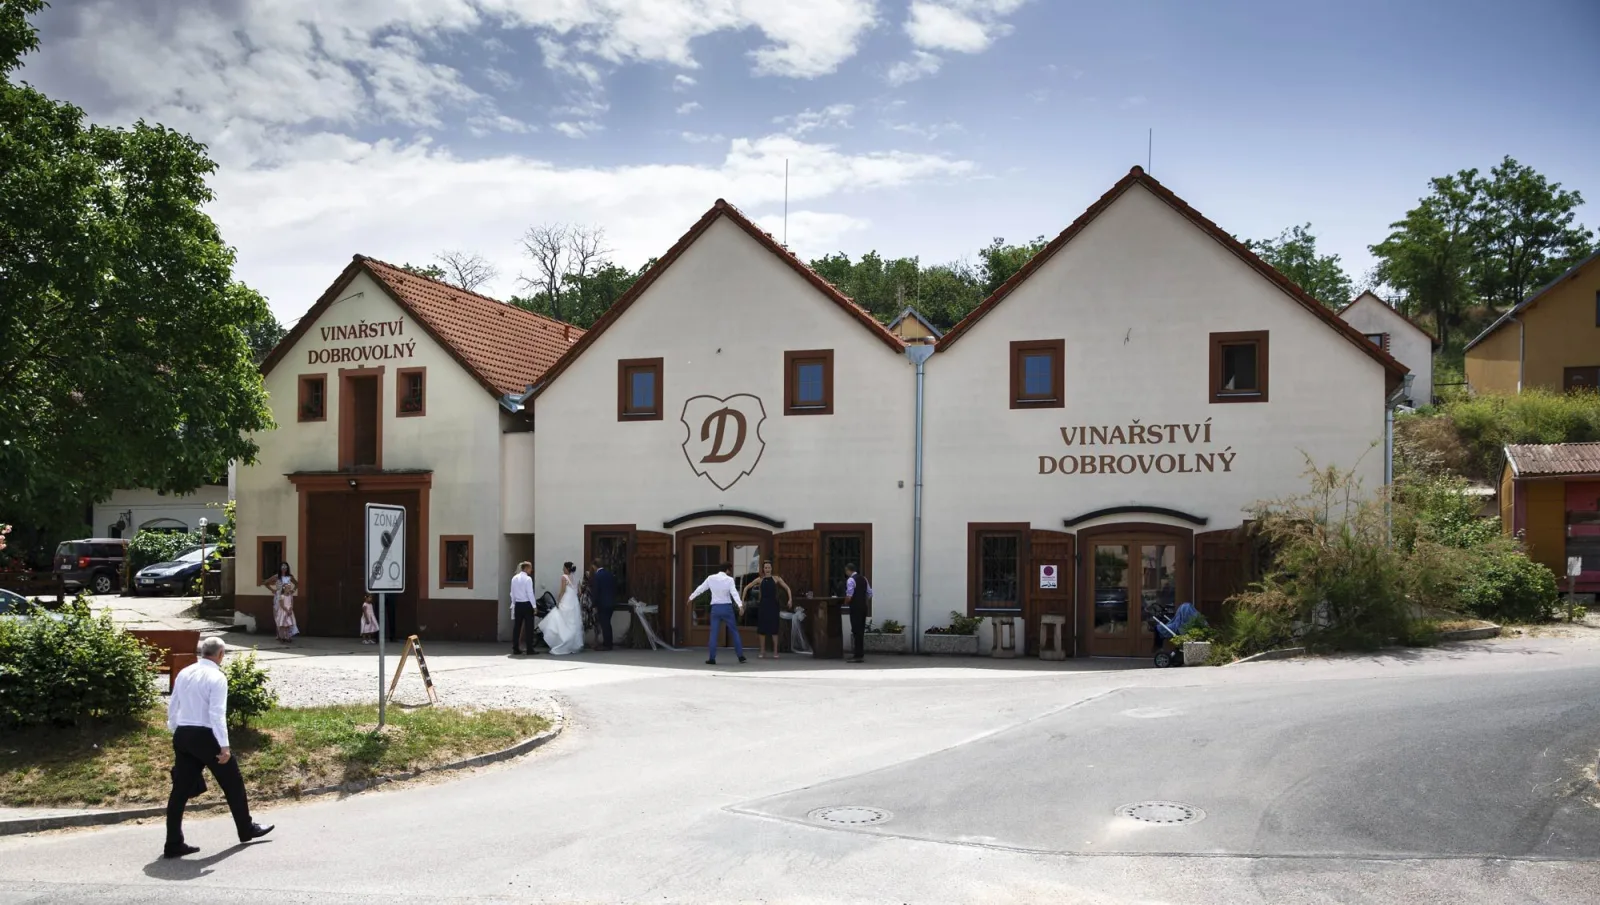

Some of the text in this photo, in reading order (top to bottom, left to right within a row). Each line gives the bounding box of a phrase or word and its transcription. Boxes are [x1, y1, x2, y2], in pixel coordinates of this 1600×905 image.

[320, 316, 404, 342] VINAŘSTVÍ
[308, 337, 417, 365] DOBROVOLNÝ
[699, 406, 747, 464] D
[1060, 417, 1213, 446] VINAŘSTVÍ
[1038, 446, 1237, 475] DOBROVOLNÝ
